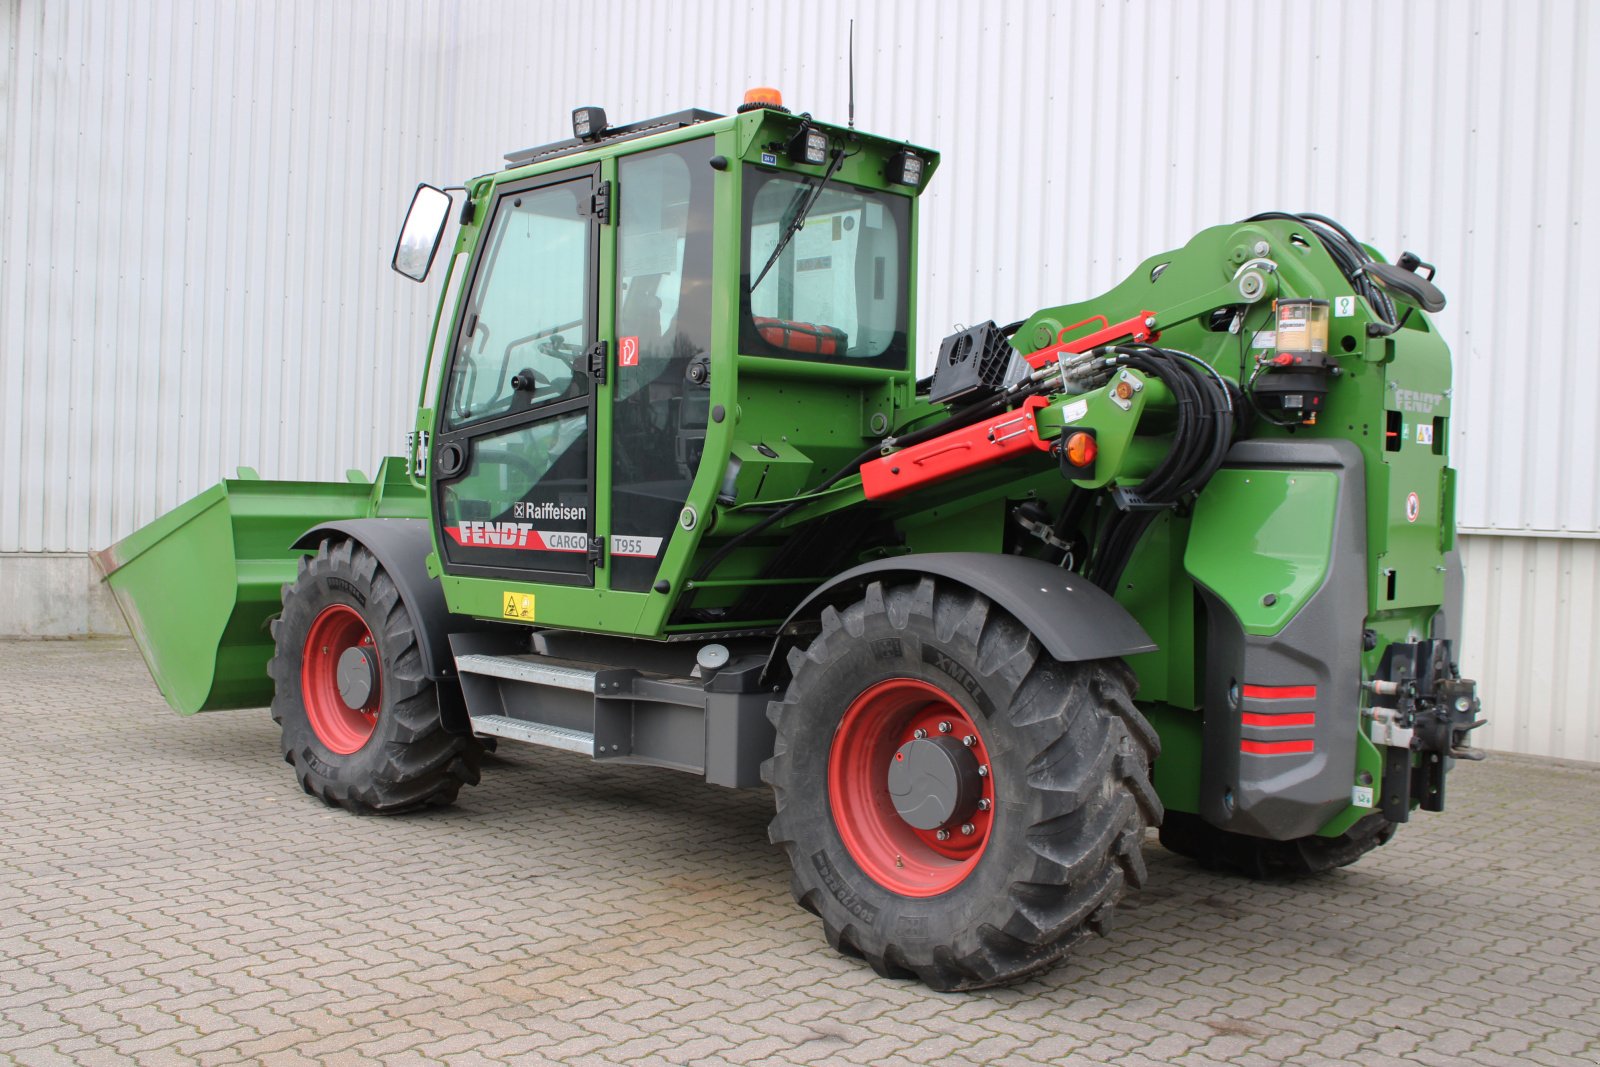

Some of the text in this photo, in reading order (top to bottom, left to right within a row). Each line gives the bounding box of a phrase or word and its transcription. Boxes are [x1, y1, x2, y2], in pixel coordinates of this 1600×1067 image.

[1395, 389, 1442, 413] FENDT
[526, 502, 586, 520] Raiffeisen
[459, 520, 533, 546] FENDT
[549, 534, 587, 549] CARGO
[615, 538, 642, 553] T955
[935, 652, 982, 703] XMCL
